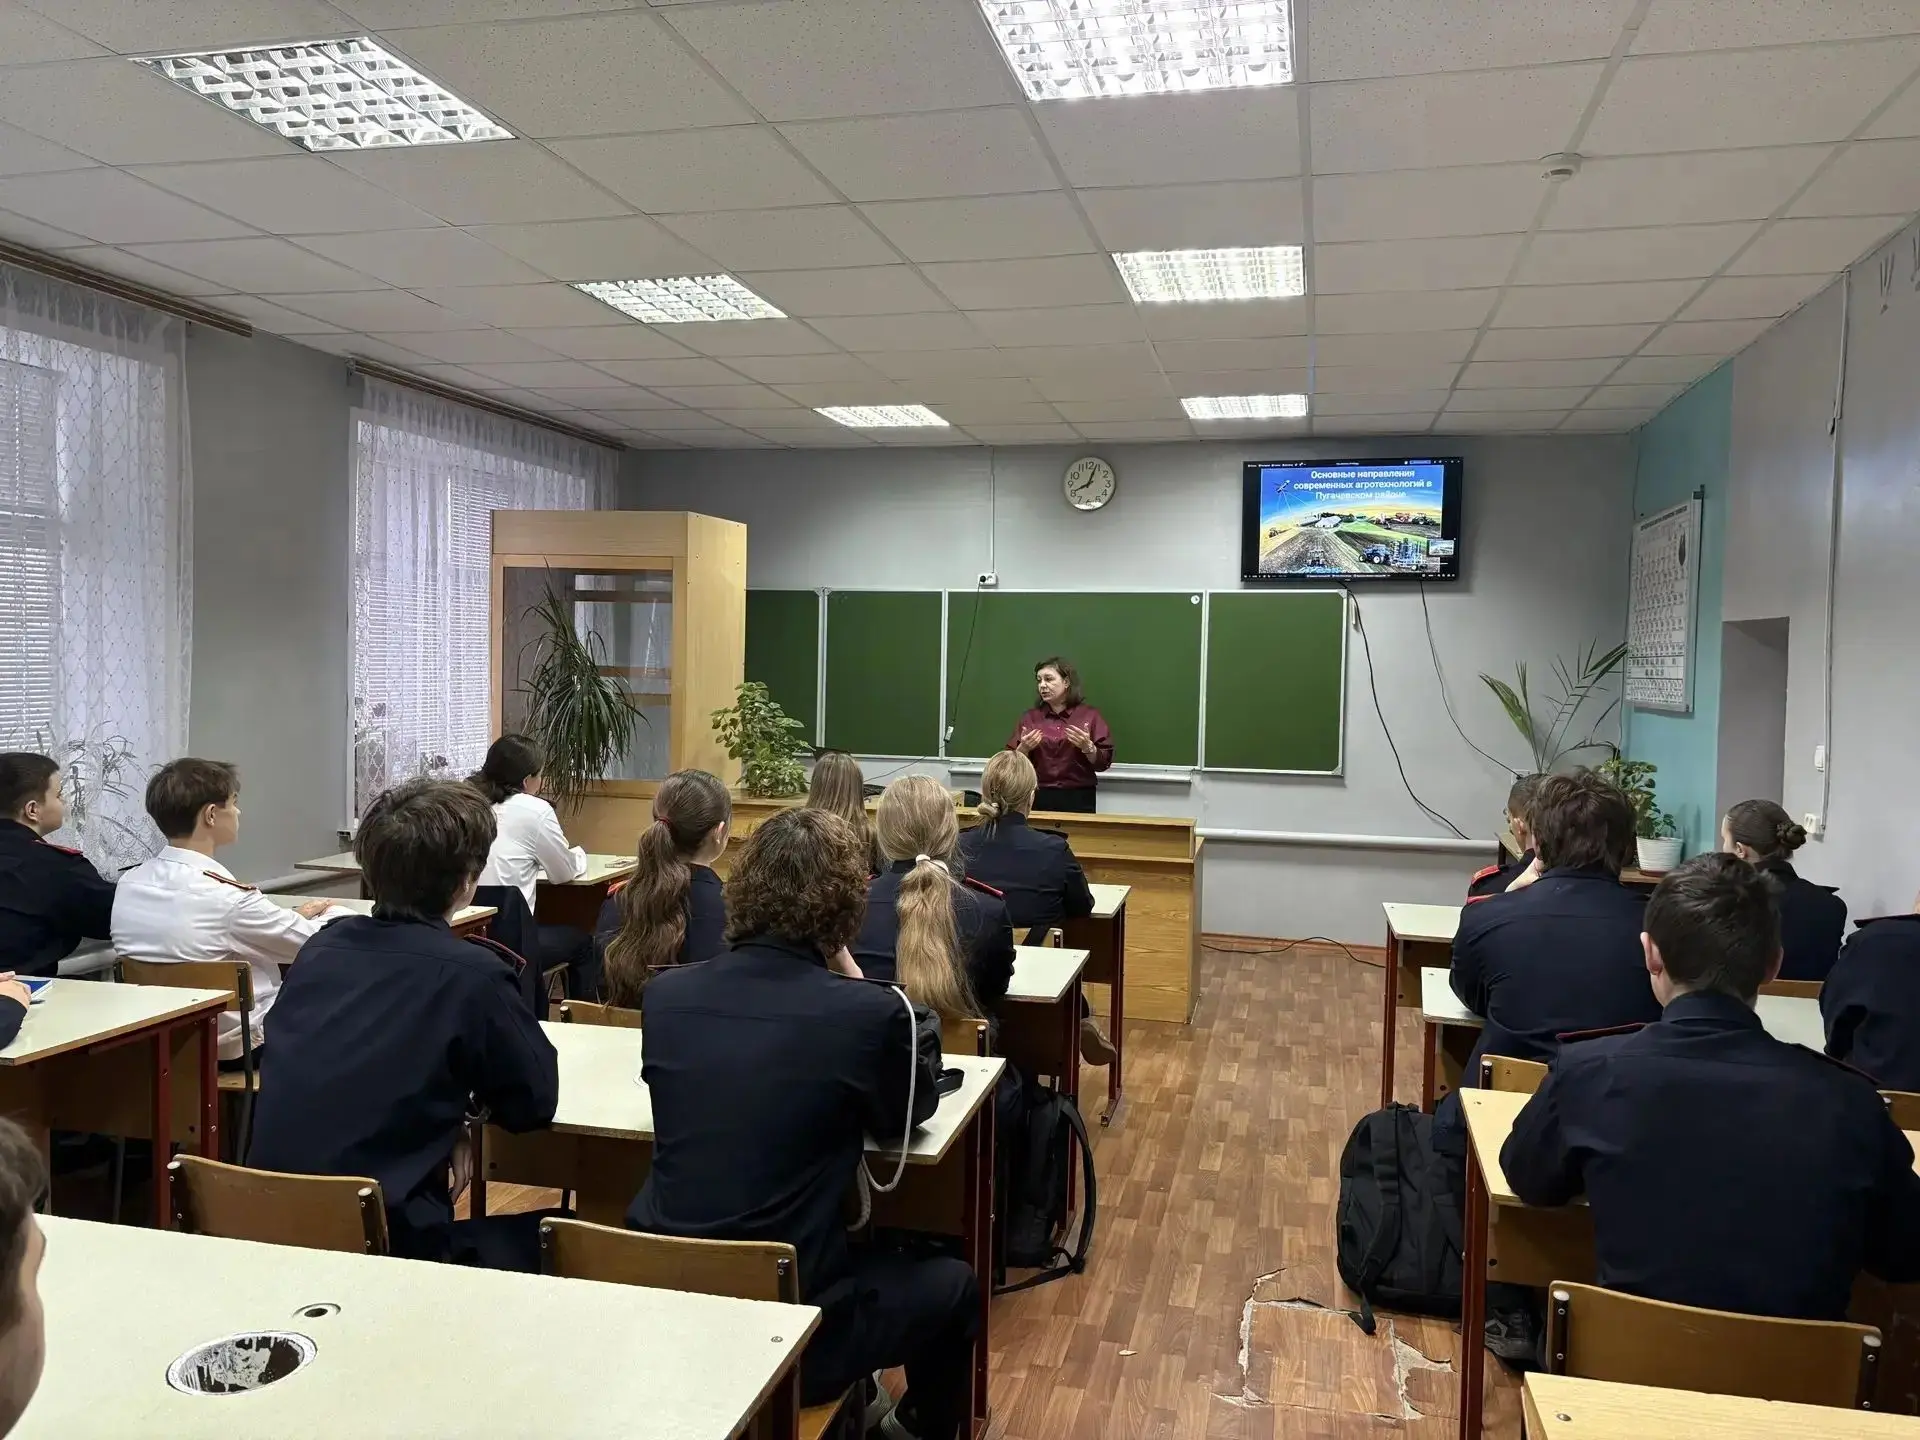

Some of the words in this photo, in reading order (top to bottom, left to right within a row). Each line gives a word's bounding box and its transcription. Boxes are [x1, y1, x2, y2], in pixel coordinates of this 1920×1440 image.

[1078, 464, 1084, 472] 11
[1086, 461, 1094, 470] 12
[1070, 472, 1080, 480] 10
[1102, 470, 1108, 478] 2
[1311, 470, 1356, 479] Основные
[1358, 470, 1415, 479] направления
[1105, 480, 1111, 488] 3
[1294, 482, 1354, 490] современных
[1355, 480, 1424, 490] агротехнологий
[1077, 496, 1082, 504] 7
